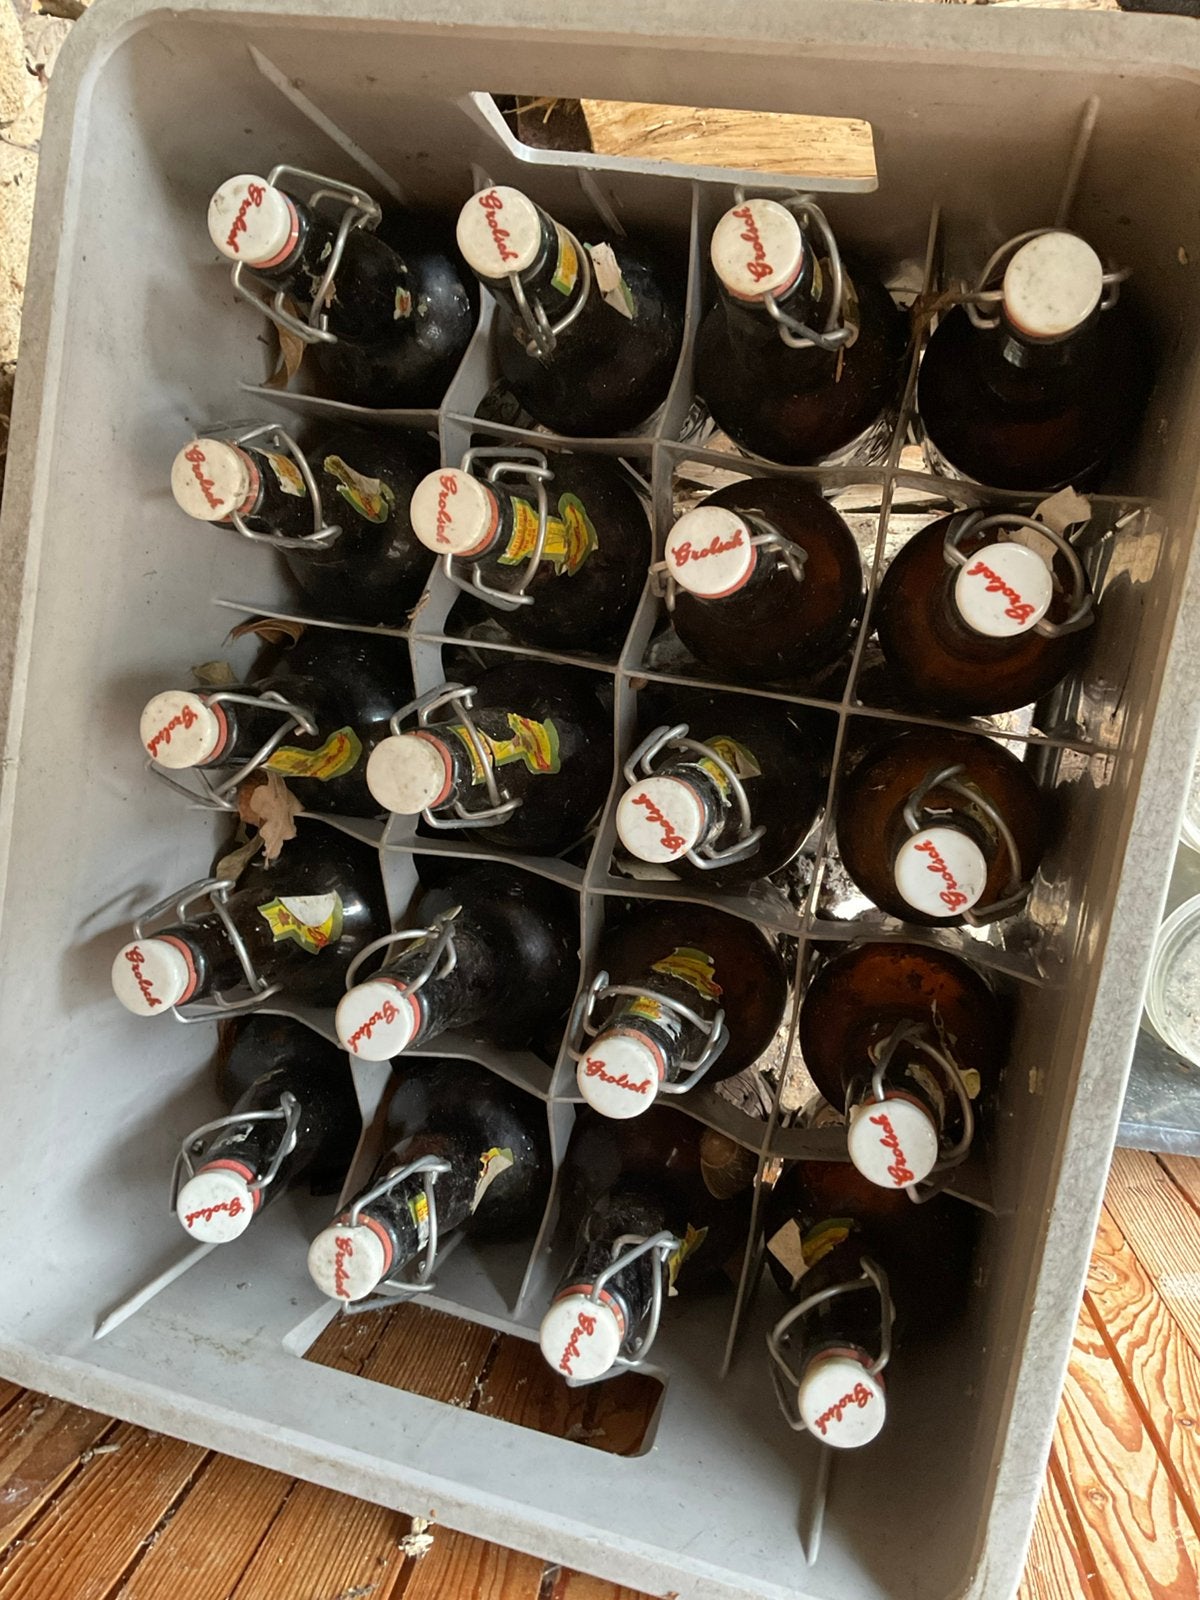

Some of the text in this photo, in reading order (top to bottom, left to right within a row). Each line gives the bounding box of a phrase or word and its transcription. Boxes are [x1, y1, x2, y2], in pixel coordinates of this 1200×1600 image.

[226, 183, 266, 254] Grolsch
[479, 190, 518, 262] Grolsch
[733, 206, 774, 283] Grolsch
[185, 444, 225, 509] Grolsch
[436, 475, 458, 546] Grolsch
[671, 529, 744, 567] Grolsch
[967, 561, 1036, 624] Grolsch
[147, 704, 198, 758] Grolsch
[631, 793, 687, 854] Grolsch
[913, 840, 967, 911] Grolsch
[125, 946, 163, 1007] Grolsch
[348, 1000, 400, 1053] Grolsch
[585, 1056, 652, 1094] Grolsch
[868, 1113, 914, 1187] Grolsch
[185, 1197, 245, 1228] Grolsch
[336, 1236, 355, 1299] Grolsch
[558, 1311, 597, 1376] Grolsch
[815, 1382, 873, 1435] Grolsch
